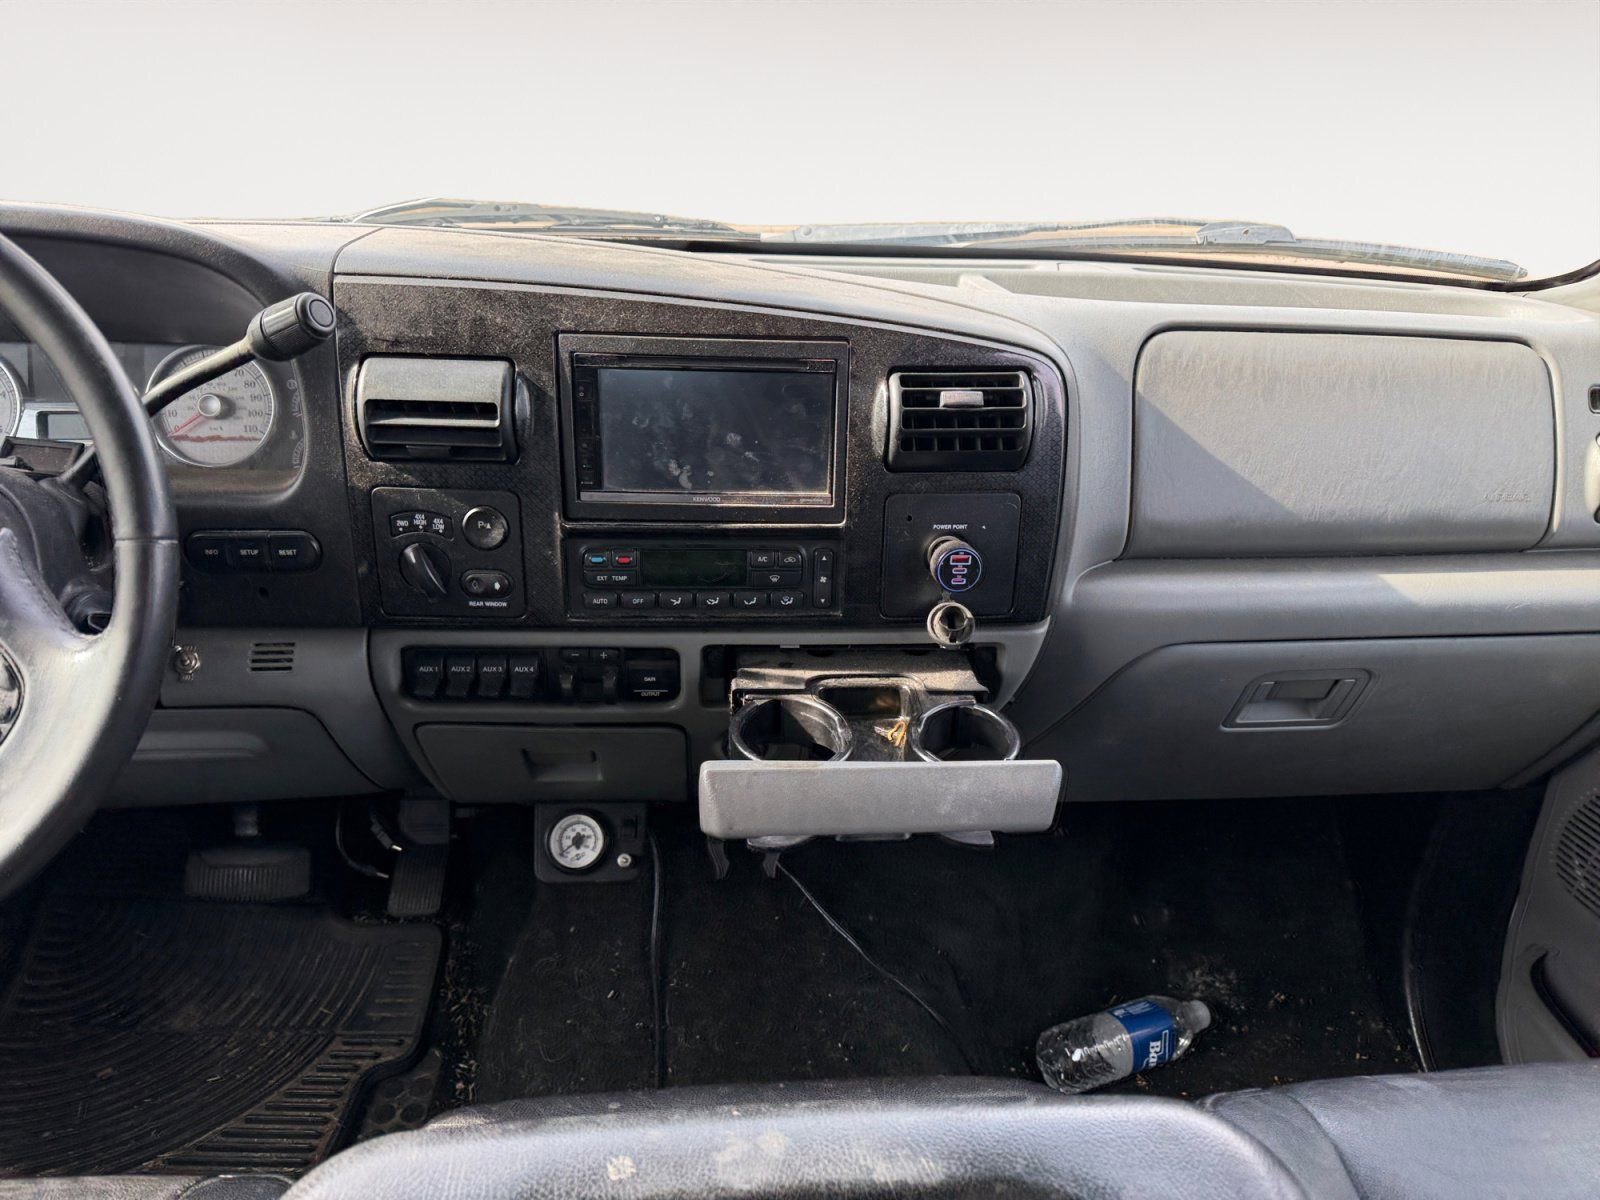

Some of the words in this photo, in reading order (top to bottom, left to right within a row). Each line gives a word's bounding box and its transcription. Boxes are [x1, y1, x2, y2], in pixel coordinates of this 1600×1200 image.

[243, 381, 256, 389] 80
[247, 408, 263, 417] 100
[243, 425, 258, 433] 110
